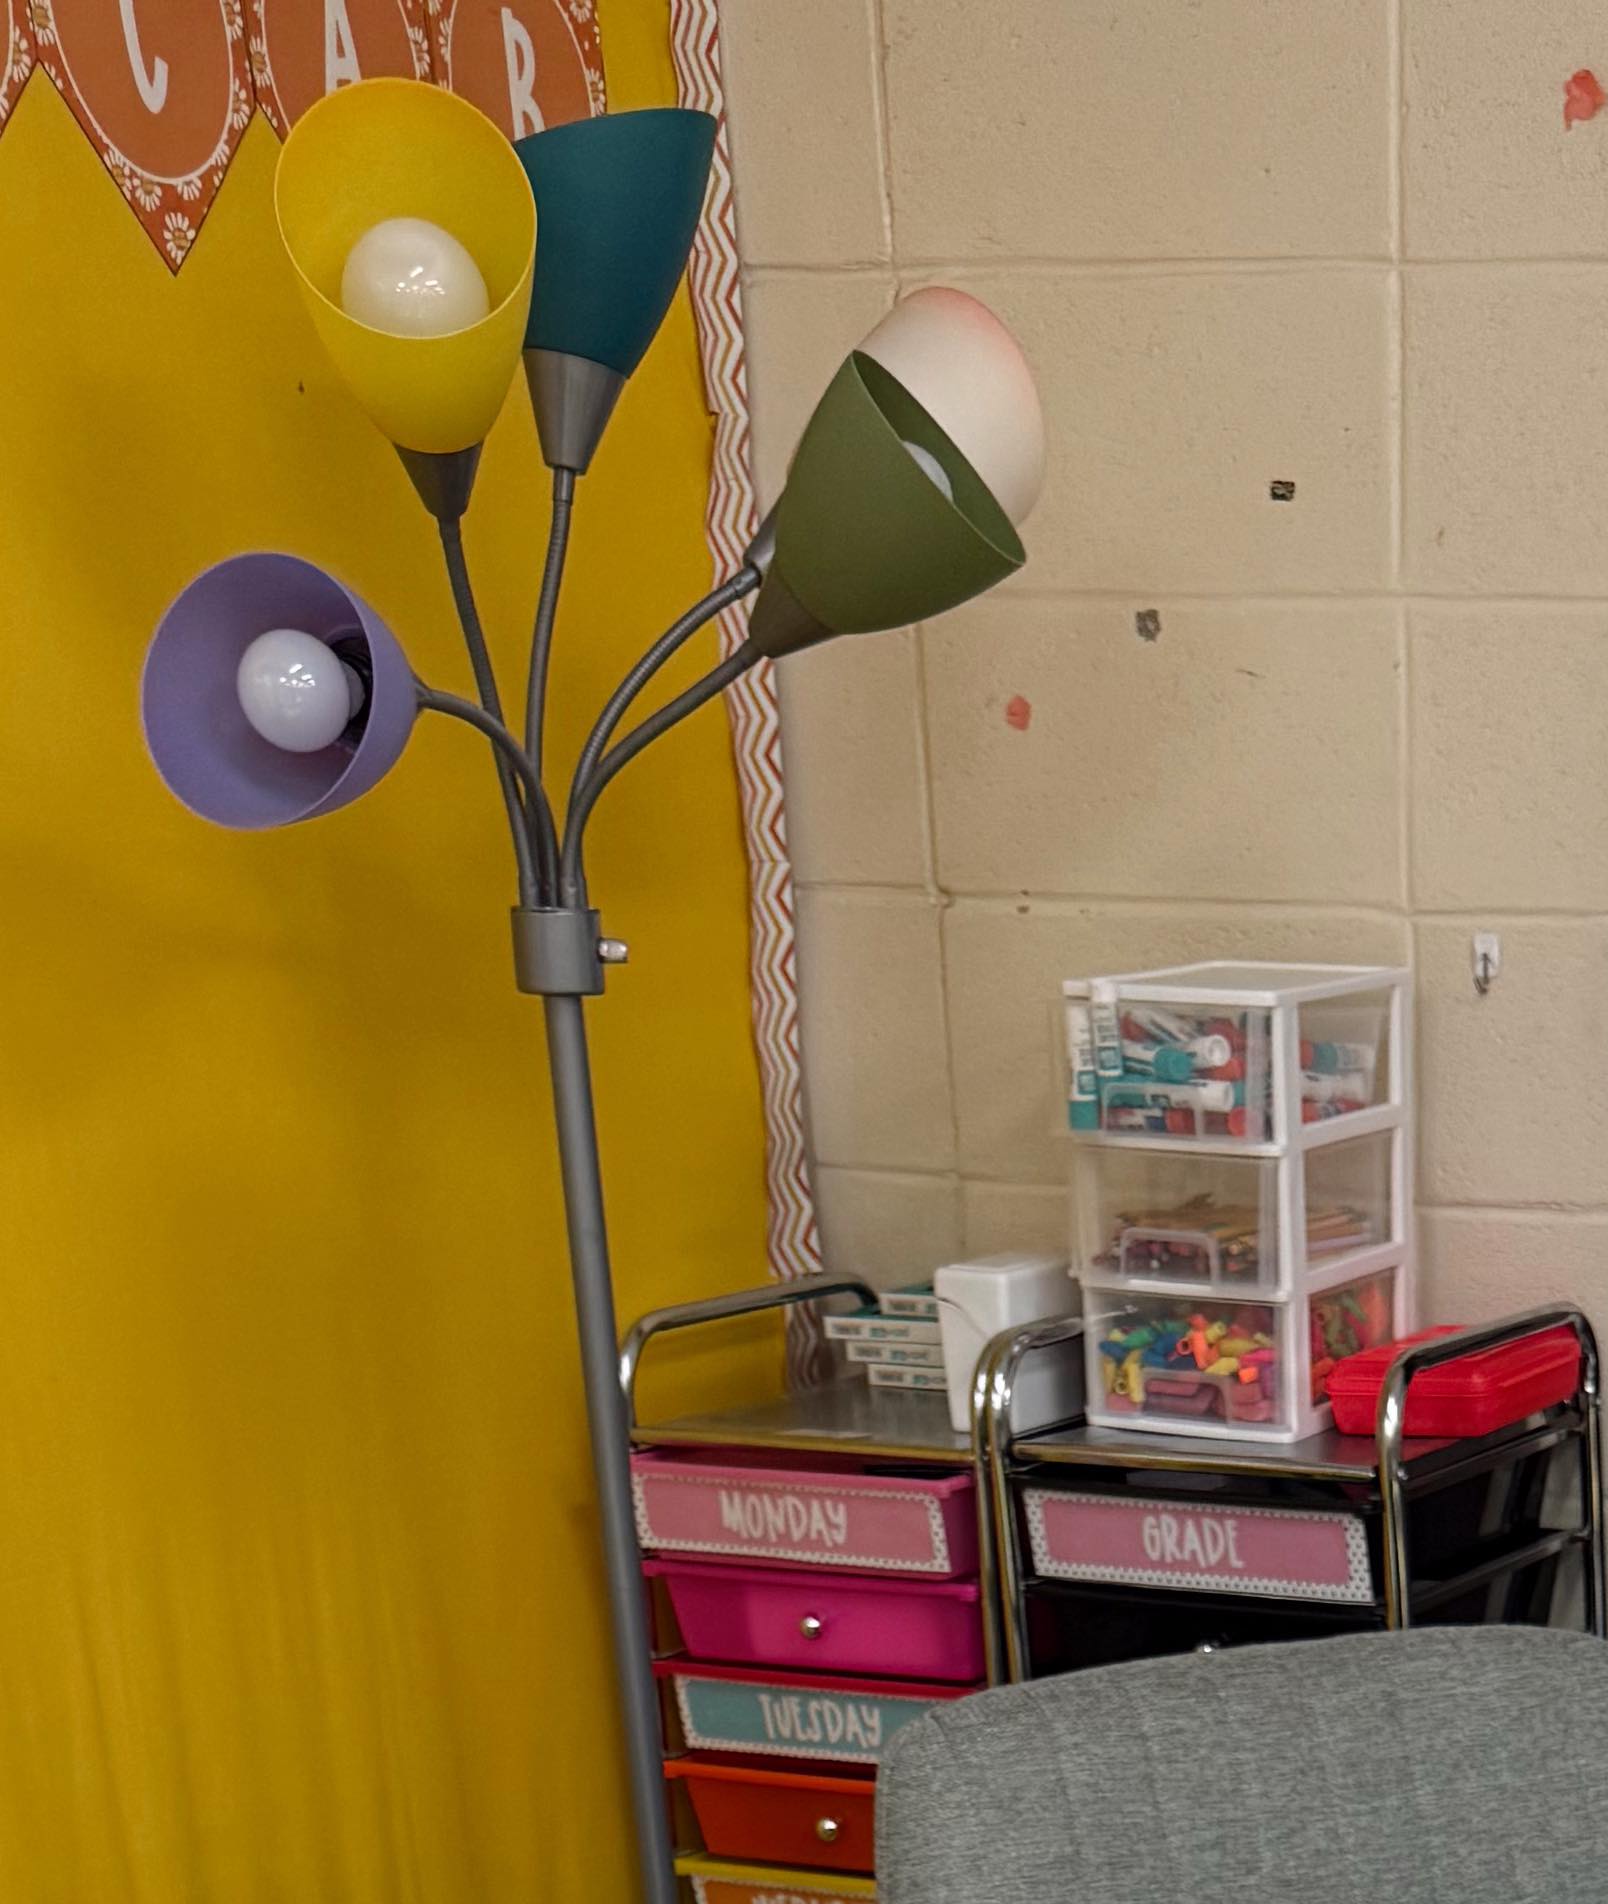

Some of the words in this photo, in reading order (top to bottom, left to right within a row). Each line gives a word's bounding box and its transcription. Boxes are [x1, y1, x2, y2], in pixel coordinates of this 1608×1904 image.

[718, 1490, 847, 1547] MONDAY
[1142, 1515, 1245, 1571] GRADE
[758, 1692, 882, 1747] TUESDAY
